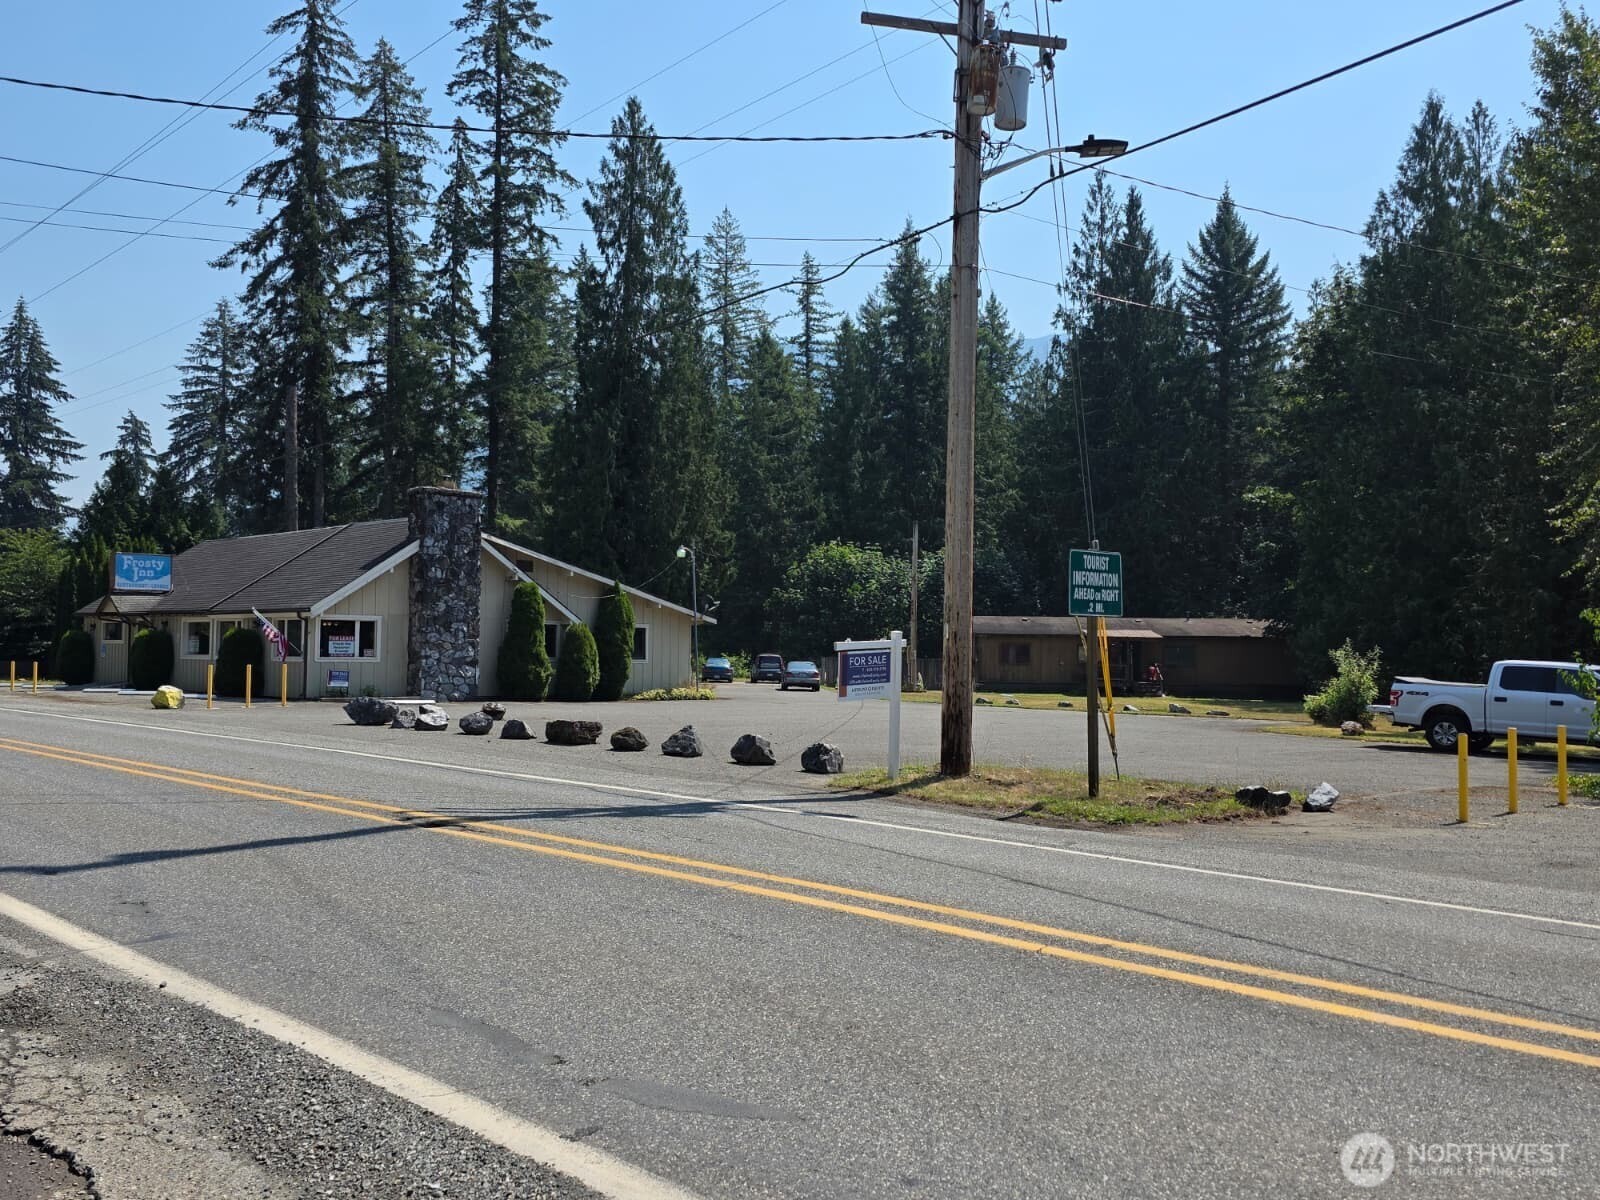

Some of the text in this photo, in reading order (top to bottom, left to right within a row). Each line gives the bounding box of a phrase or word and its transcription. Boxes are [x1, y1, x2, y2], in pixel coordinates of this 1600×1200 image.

[121, 556, 164, 570] Frosty
[1083, 555, 1109, 571] TOURIST
[133, 567, 155, 581] Inn
[1073, 571, 1119, 587] INFORMATION
[1073, 587, 1095, 600] AHEAD
[1101, 589, 1119, 602] RIGHT
[849, 656, 887, 666] FOR SALE
